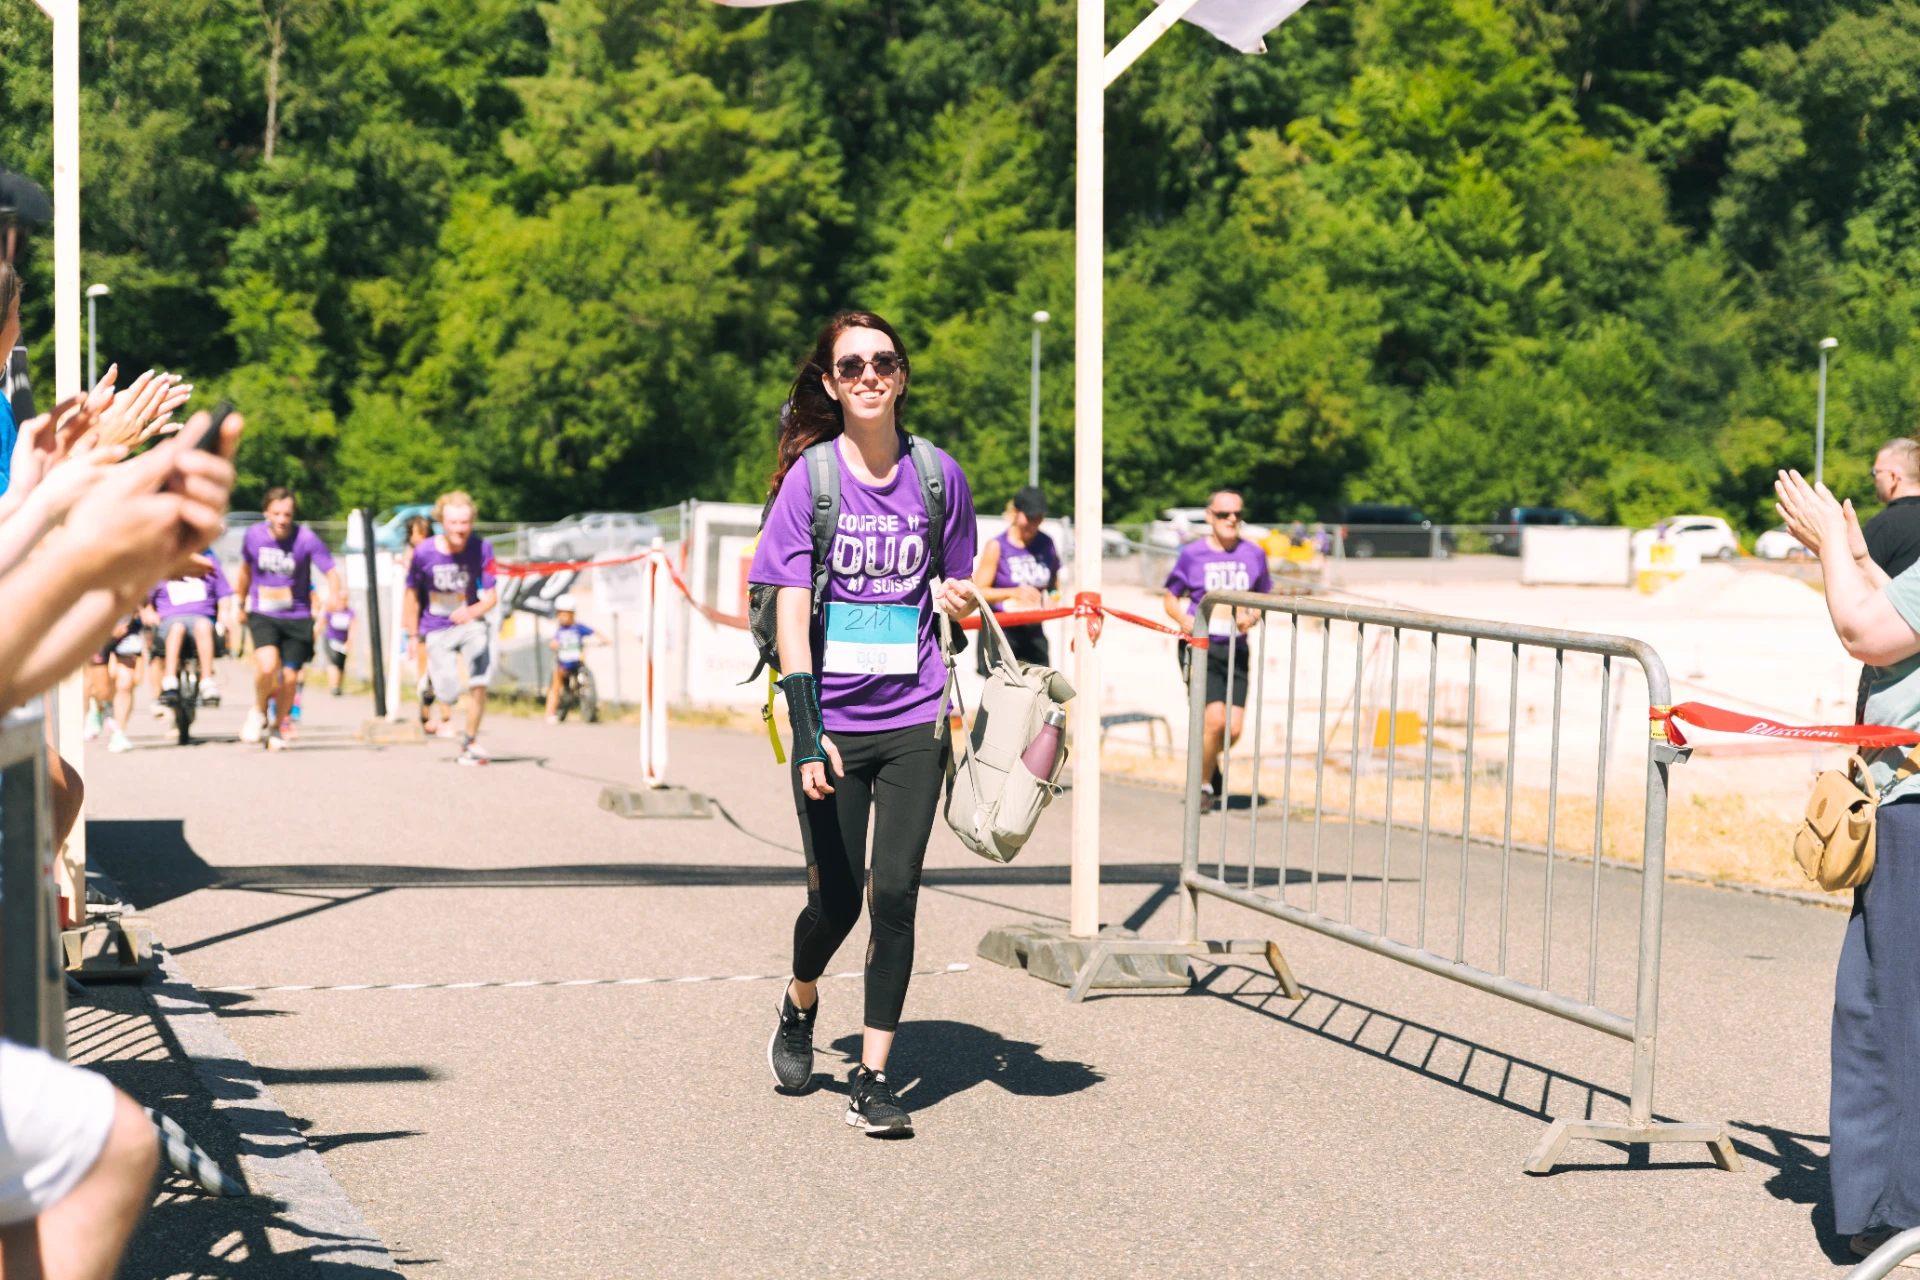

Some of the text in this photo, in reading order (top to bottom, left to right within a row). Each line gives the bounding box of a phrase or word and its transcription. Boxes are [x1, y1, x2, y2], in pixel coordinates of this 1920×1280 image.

[837, 513, 899, 532] COURSE
[832, 533, 924, 577] DUO
[844, 608, 891, 631] 211
